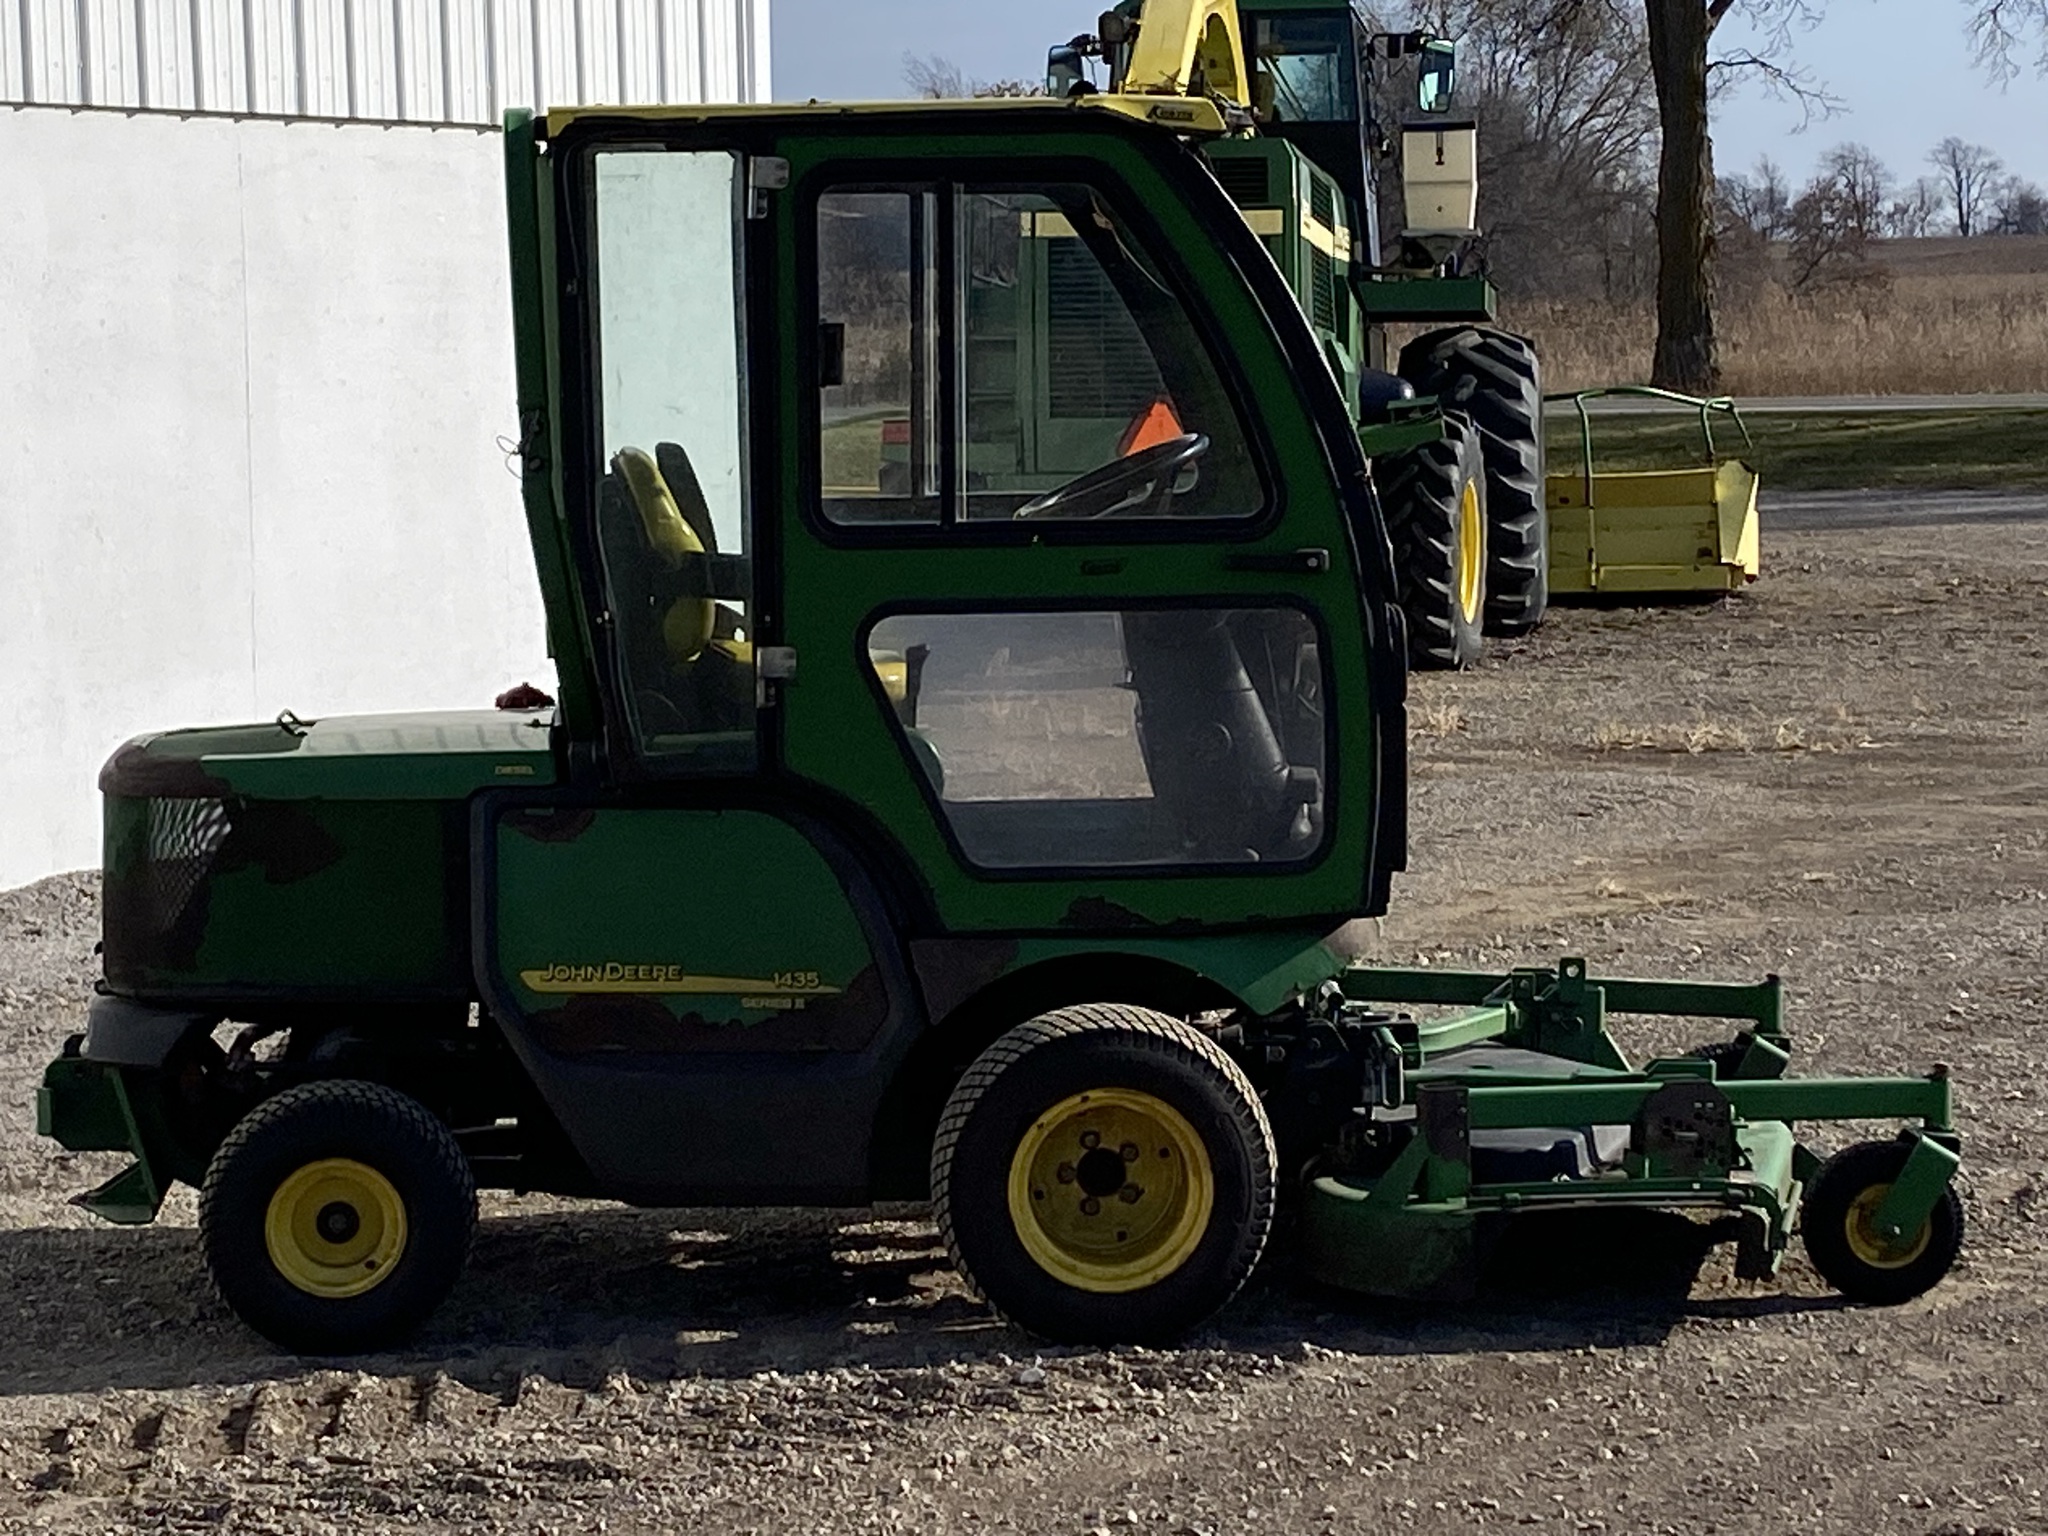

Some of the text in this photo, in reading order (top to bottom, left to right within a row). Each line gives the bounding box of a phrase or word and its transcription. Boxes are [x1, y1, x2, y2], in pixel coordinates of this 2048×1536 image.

[542, 961, 683, 981] JOHN DEERE
[773, 971, 820, 987] 1435
